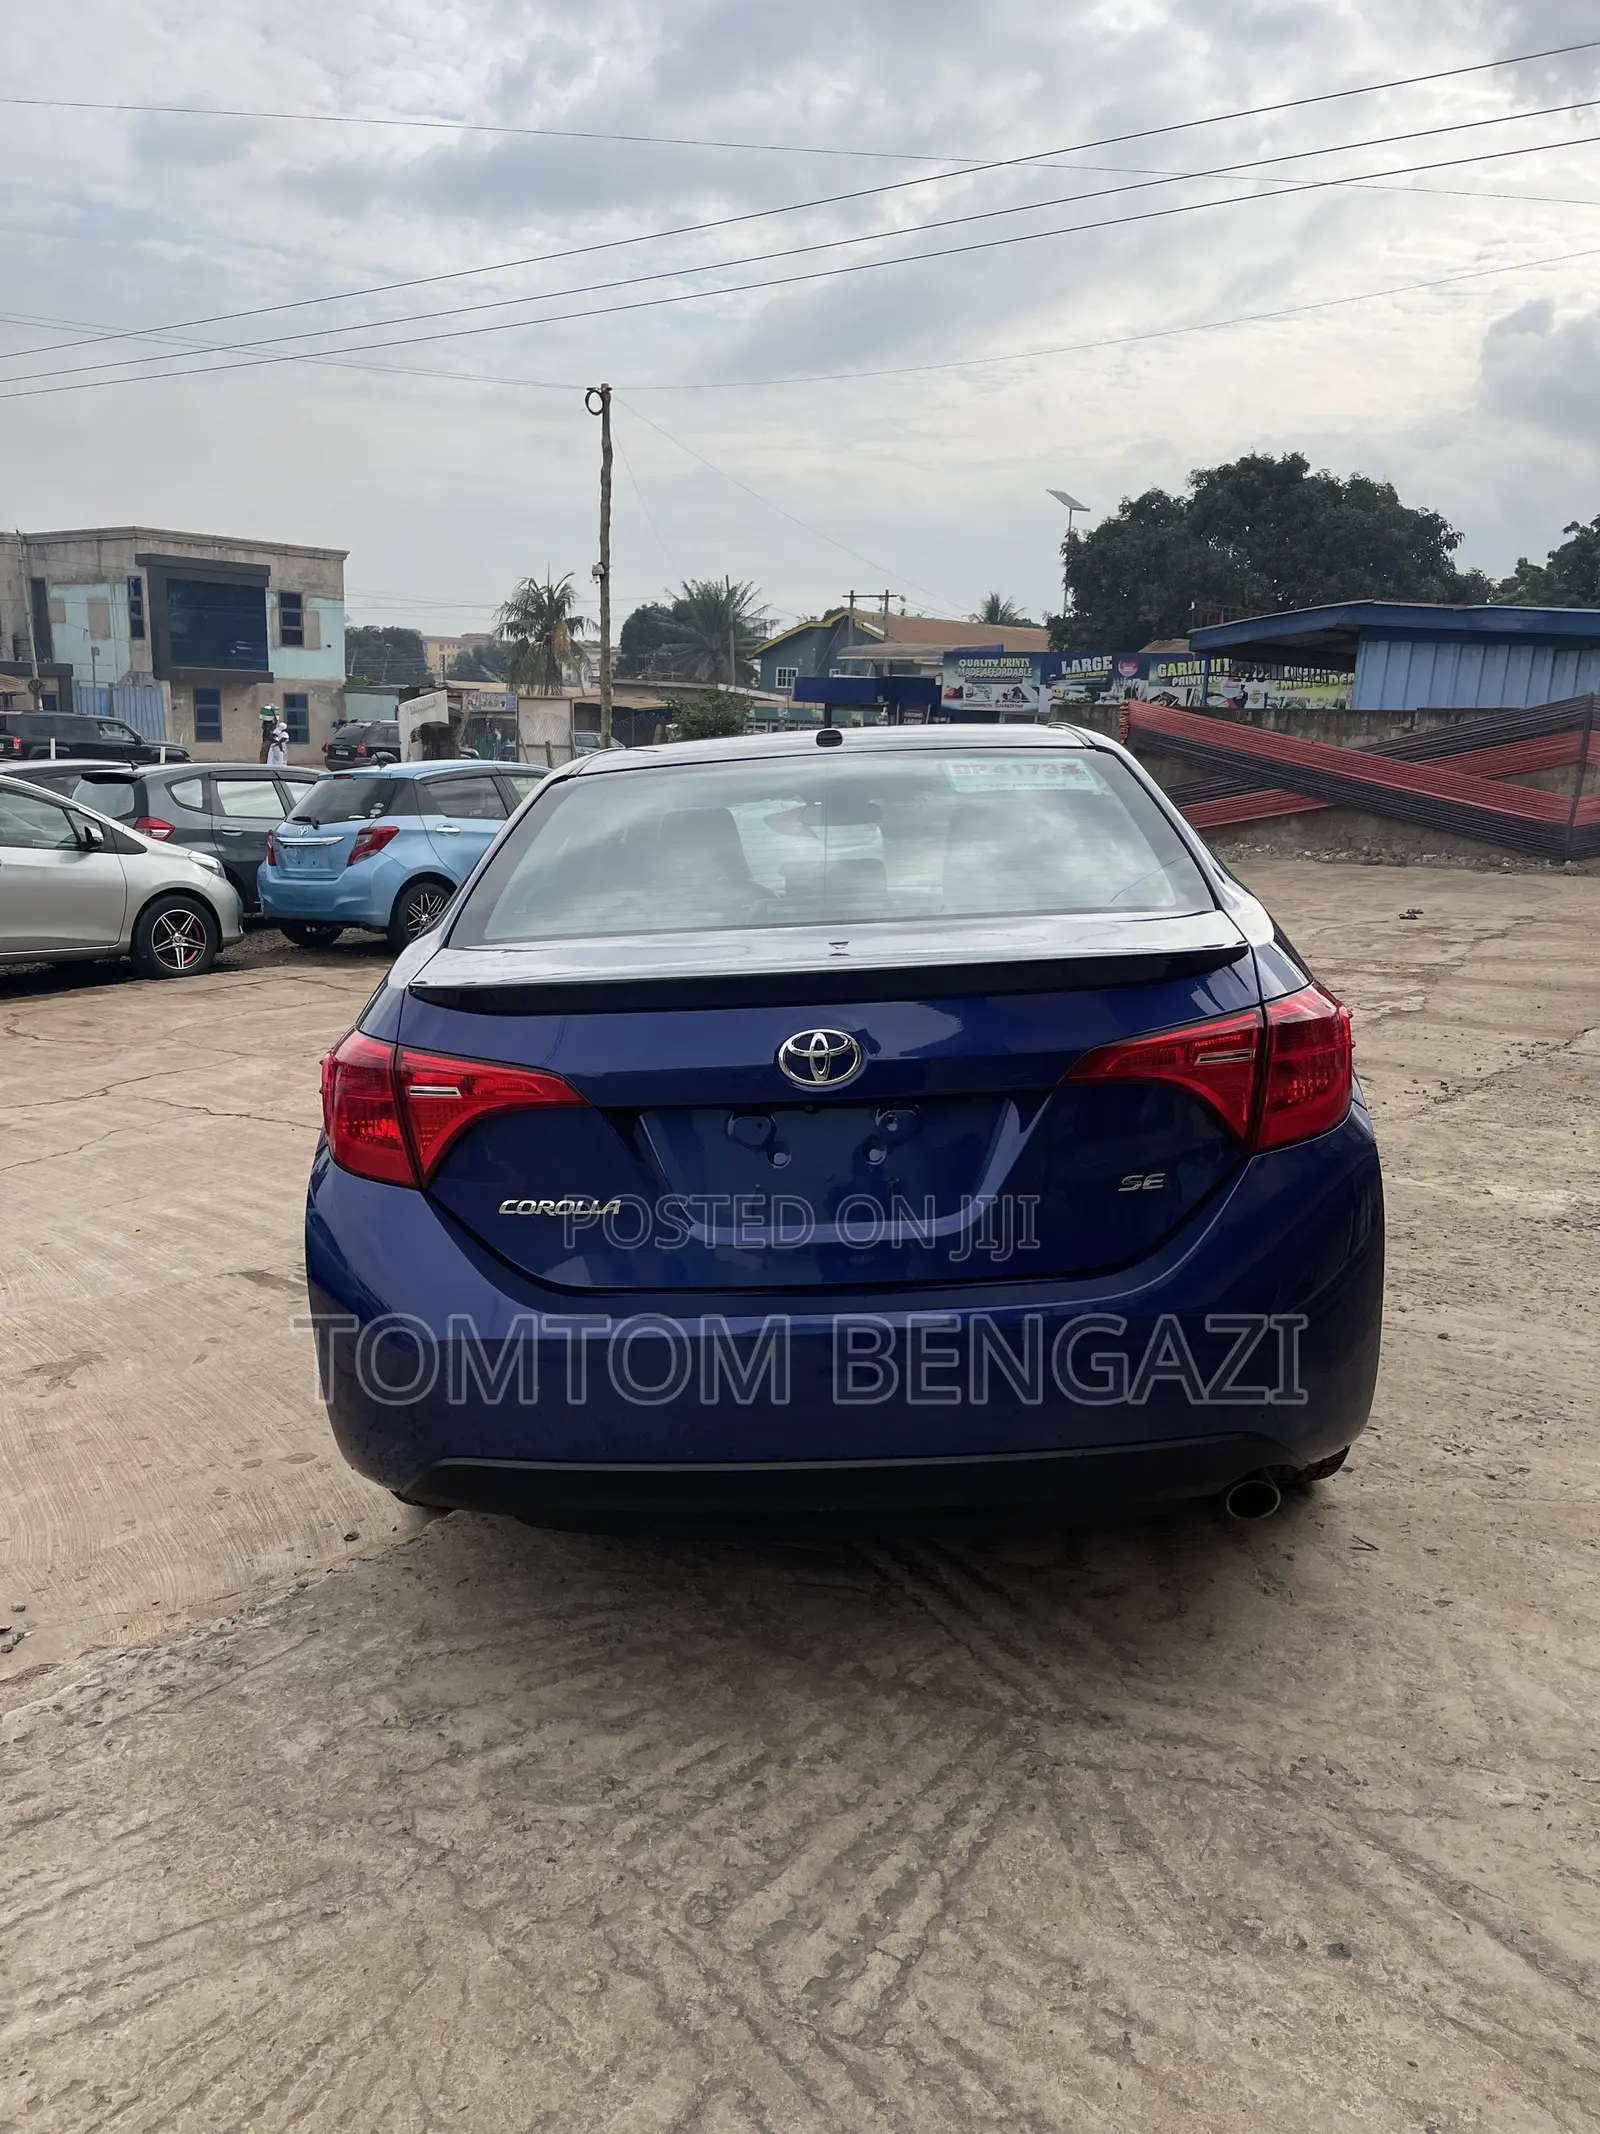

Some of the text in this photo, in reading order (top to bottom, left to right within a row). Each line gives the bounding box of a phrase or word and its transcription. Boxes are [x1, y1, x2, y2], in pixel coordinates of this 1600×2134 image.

[958, 657, 1030, 668] QUALITY PRINTS
[1061, 656, 1113, 674] LARGE
[957, 667, 1033, 677] MADE AFFORDABLE
[1117, 1173, 1166, 1192] SE
[499, 1199, 622, 1216] COROLLA
